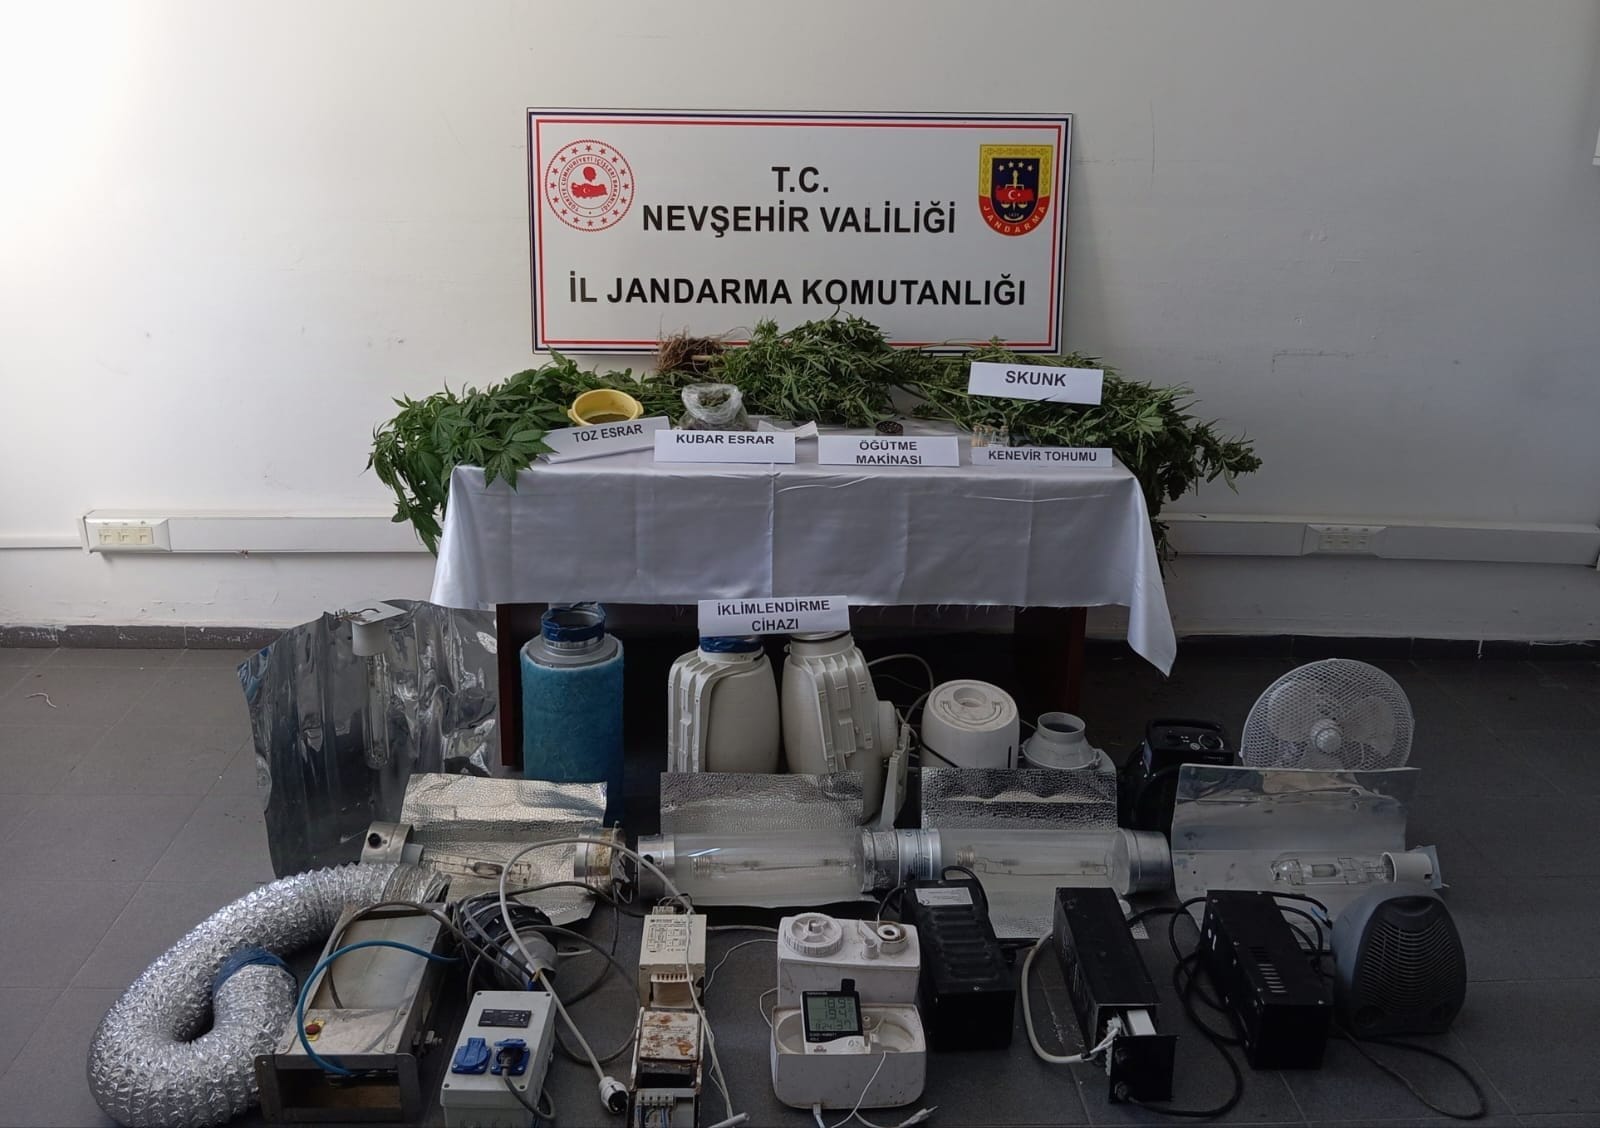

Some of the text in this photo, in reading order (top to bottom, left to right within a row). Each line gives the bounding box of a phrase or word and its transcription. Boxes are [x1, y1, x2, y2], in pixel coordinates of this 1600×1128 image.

[771, 166, 829, 193] T.C.
[643, 200, 956, 238] NEVŞEHİR VALİLİĞİ
[983, 206, 1046, 233] JANDARMA
[570, 270, 1026, 305] İL JANDARMA KOMUTANLIĞI
[1005, 370, 1067, 387] SKUNK
[572, 424, 644, 443] TOZ ESRAR
[676, 434, 775, 445] KUBAR ESRAR
[859, 439, 918, 451] ÖĞÜTME
[856, 453, 922, 465] MAKİNASI
[988, 449, 1097, 462] KENEVİR TOHUMU
[717, 598, 831, 616] İKLİMLENDİRME
[751, 617, 799, 632] CİHAZI
